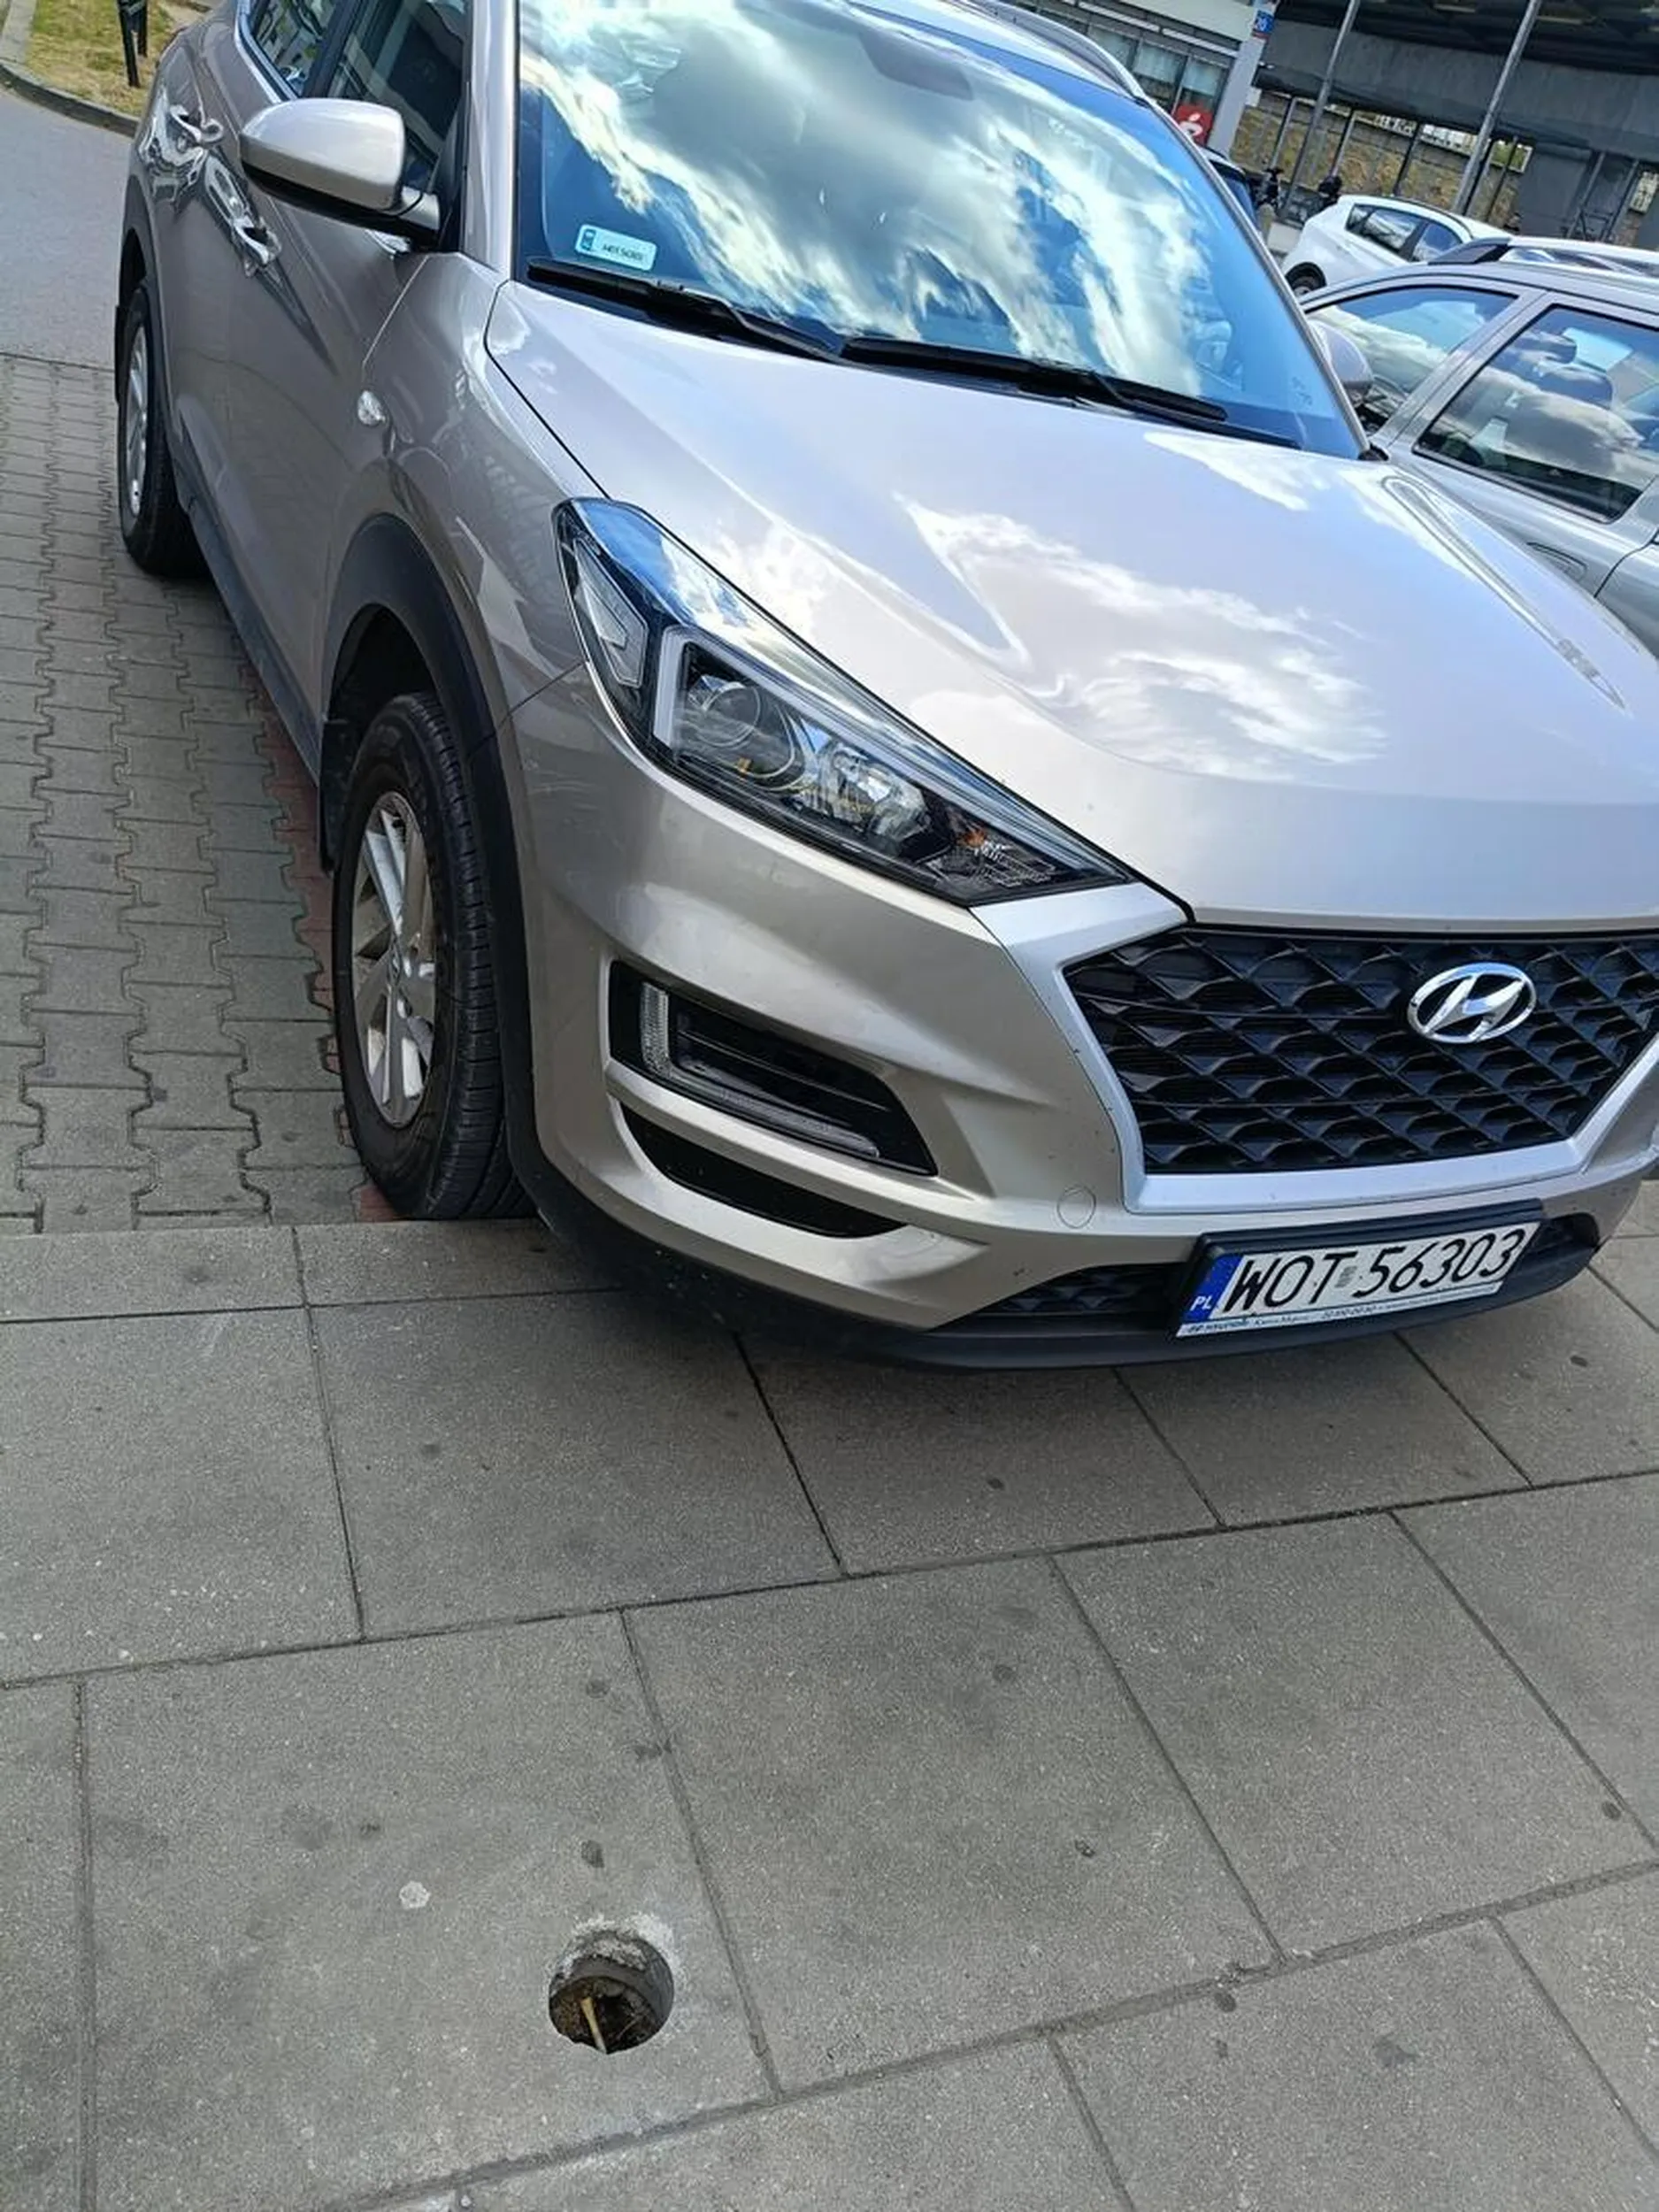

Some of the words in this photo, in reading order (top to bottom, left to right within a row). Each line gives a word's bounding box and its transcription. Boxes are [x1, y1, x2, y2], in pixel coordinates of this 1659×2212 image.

[1224, 1252, 1358, 1312] WOT
[1355, 1229, 1525, 1297] 56303
[1190, 1296, 1213, 1311] PL
